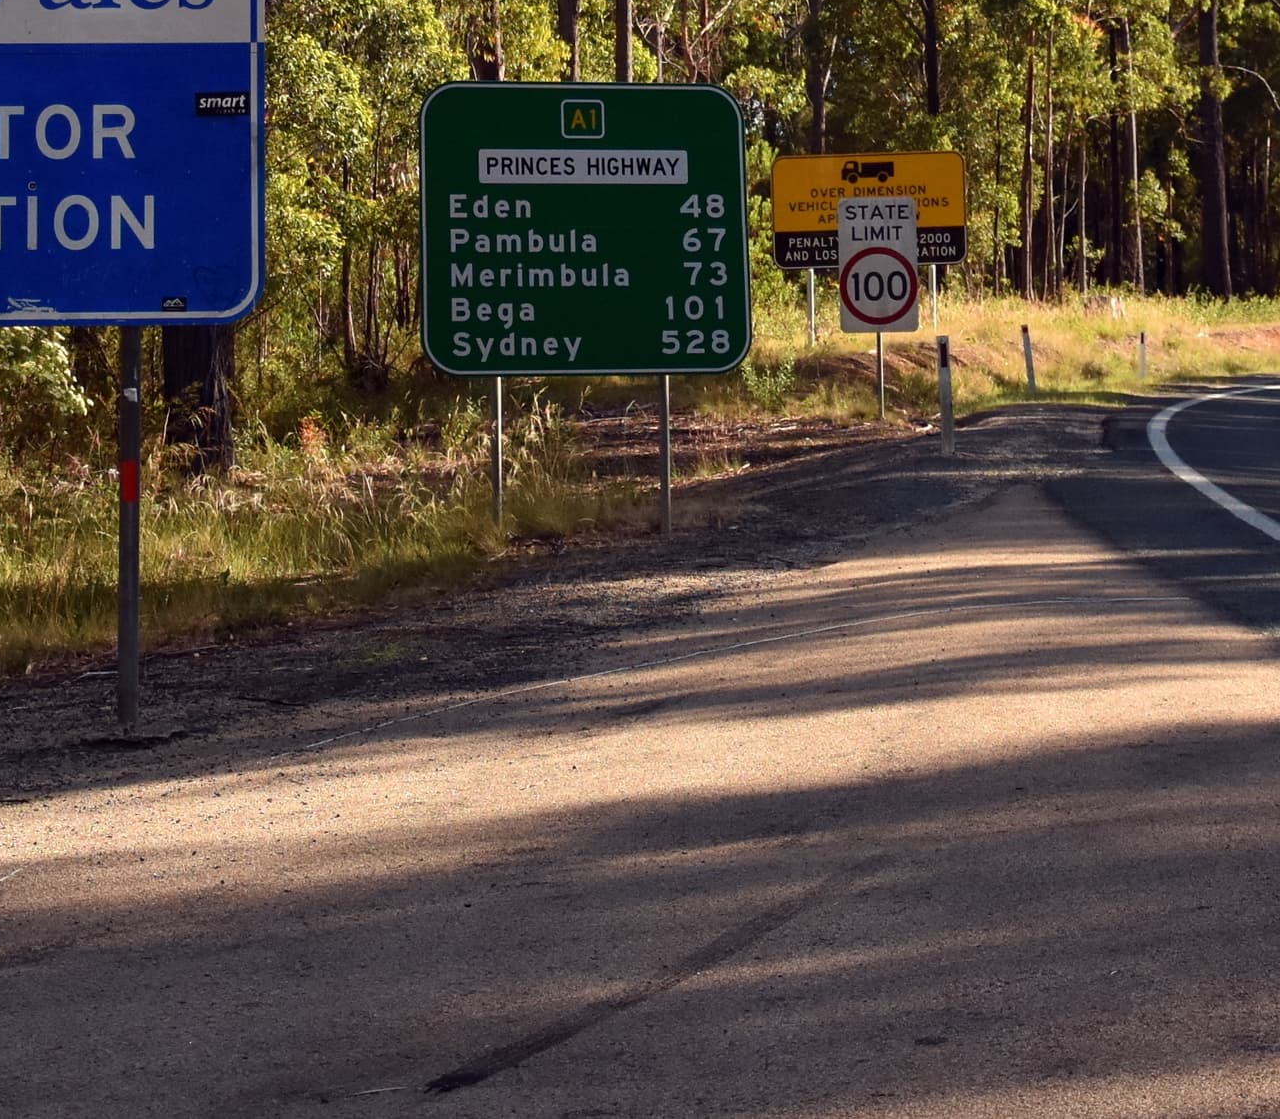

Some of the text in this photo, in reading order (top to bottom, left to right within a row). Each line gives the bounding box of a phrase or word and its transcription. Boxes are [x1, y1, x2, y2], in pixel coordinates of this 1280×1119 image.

[199, 94, 246, 109] smart
[570, 108, 598, 131] A1
[485, 156, 681, 177] PRINCES HIGHWAY
[810, 185, 926, 198] OVER DIMENSION
[449, 193, 725, 219] Eden 48
[788, 201, 837, 212] VEHICL
[844, 204, 910, 220] STATE
[450, 228, 727, 253] Pambula 67
[851, 225, 903, 241] LIMIT
[918, 233, 951, 244] 2000
[784, 249, 838, 262] AND LOS
[451, 261, 728, 287] Merimbula 73
[850, 270, 908, 302] 100
[451, 295, 725, 328] Bega 101
[452, 329, 731, 362] Sydney 528
